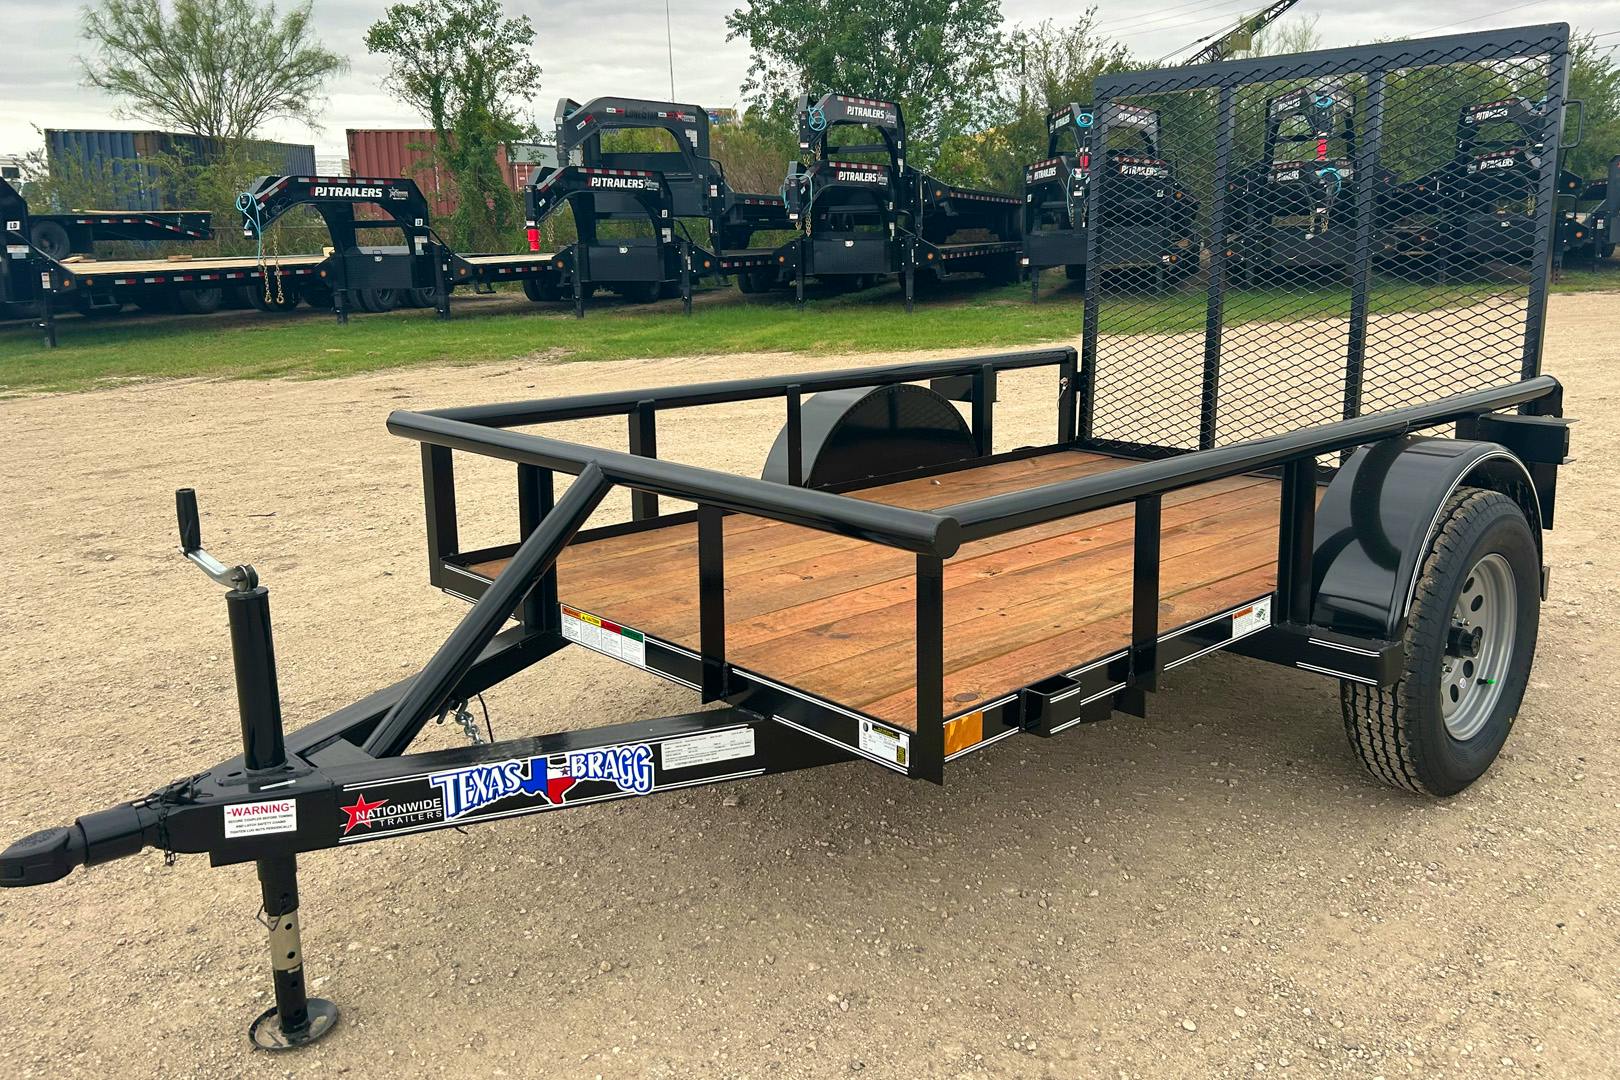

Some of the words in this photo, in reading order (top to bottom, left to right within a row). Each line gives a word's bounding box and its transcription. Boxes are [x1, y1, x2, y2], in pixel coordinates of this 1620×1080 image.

[431, 762, 521, 818] TEXAS
[569, 745, 653, 792] BRAGG
[355, 797, 443, 821] NATIONWIDE
[379, 810, 443, 827] TRAILERS
